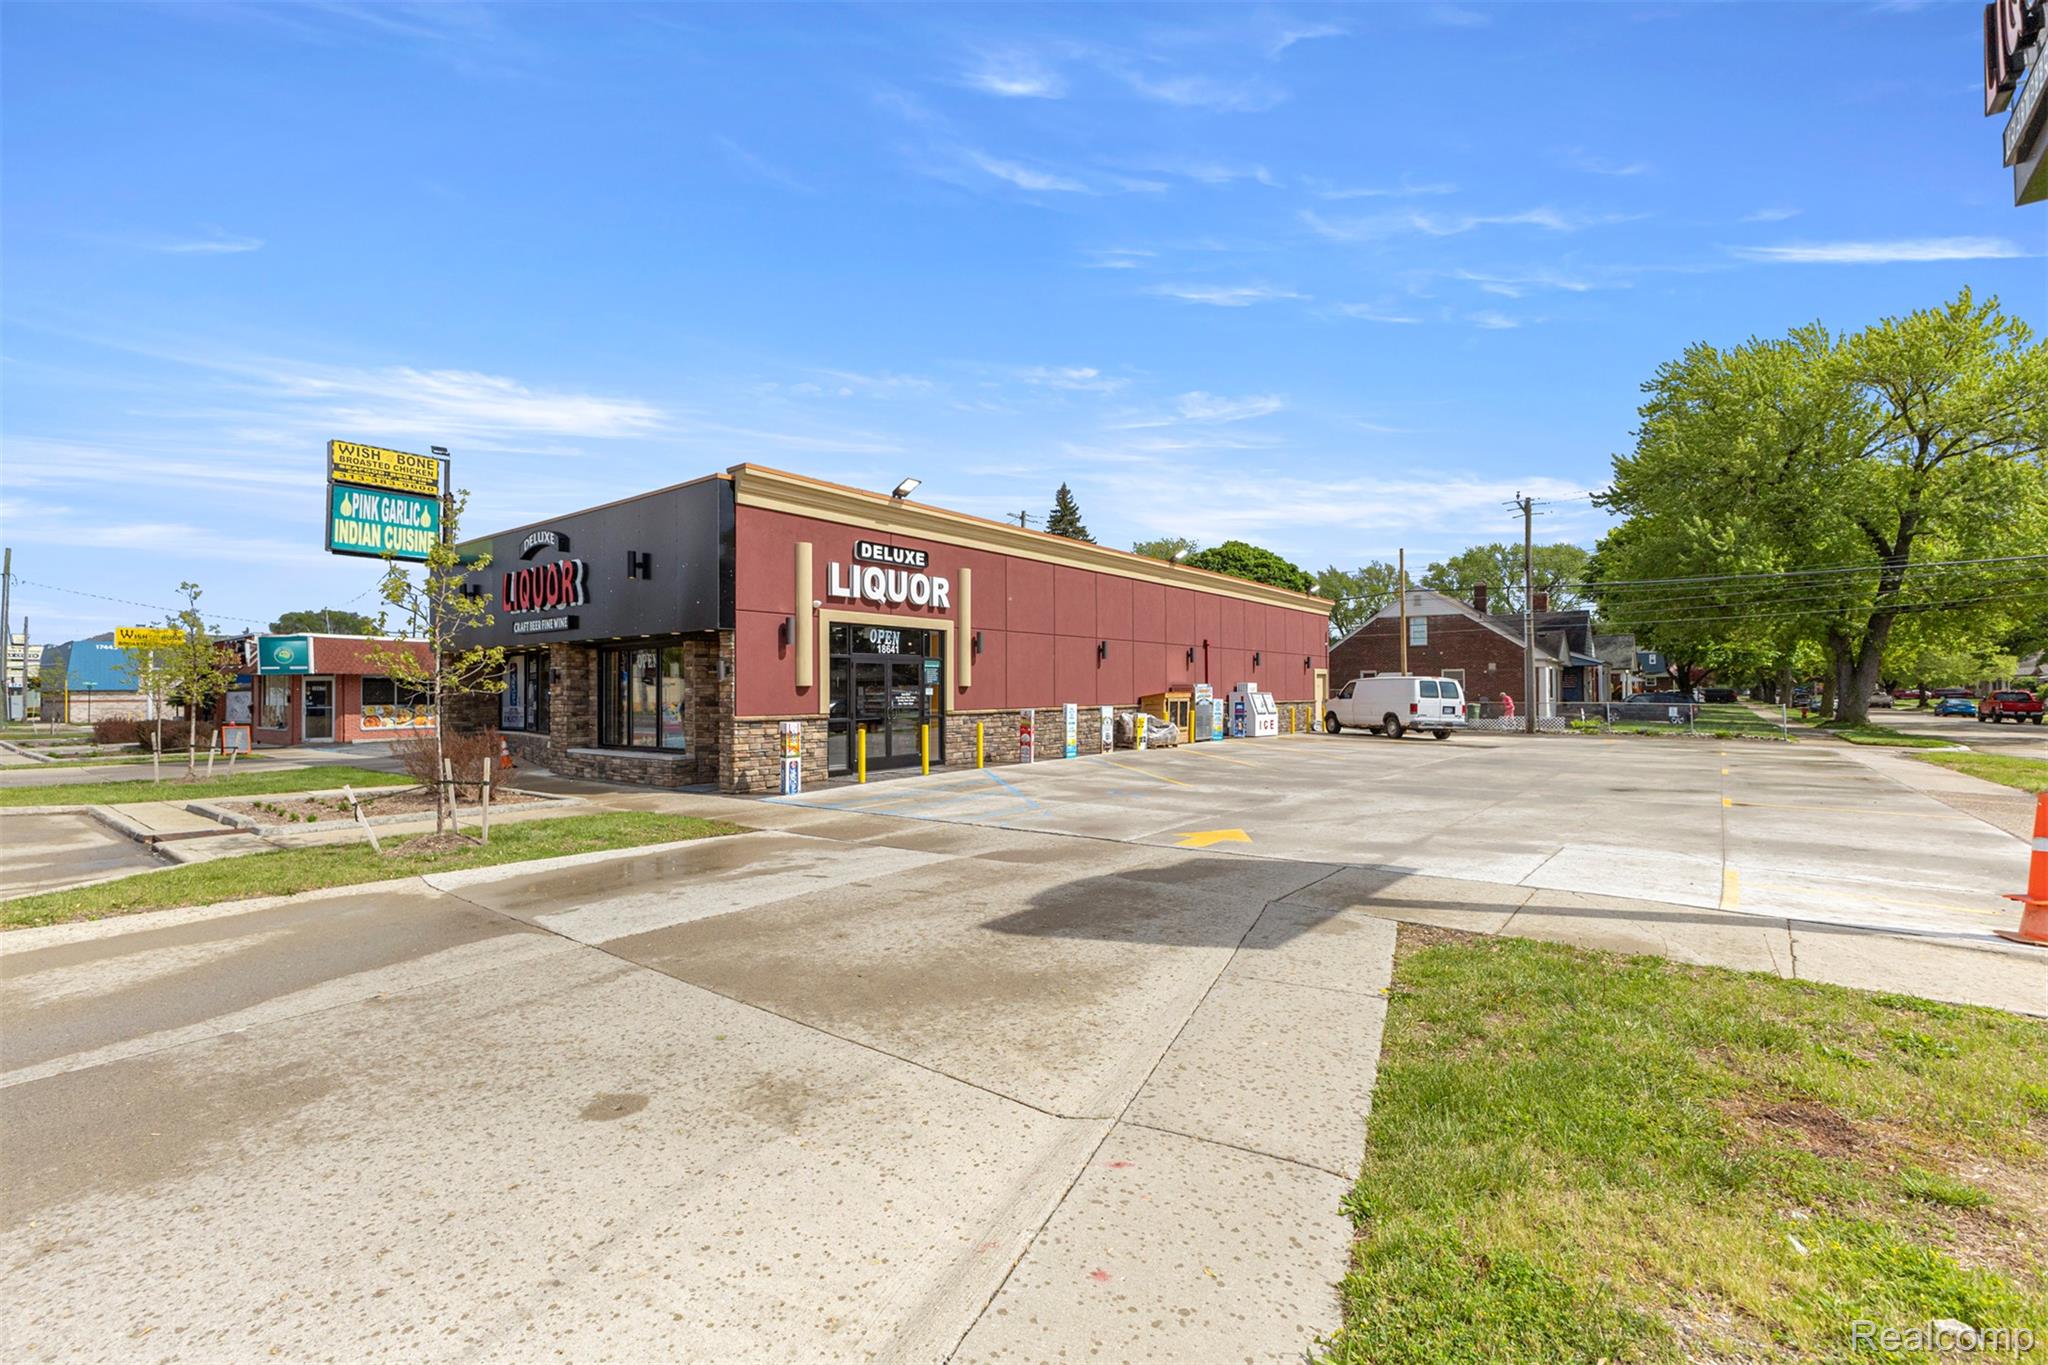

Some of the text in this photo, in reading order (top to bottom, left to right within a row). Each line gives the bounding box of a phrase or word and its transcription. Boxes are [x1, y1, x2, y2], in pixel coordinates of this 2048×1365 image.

[338, 443, 434, 471] WISH BONE
[339, 455, 391, 470] BROASTED
[393, 464, 434, 478] CHICKEN
[352, 492, 420, 527] PINK GARLIC
[334, 518, 435, 553] INDIAN CUISINE
[523, 531, 555, 551] DELUXE
[861, 542, 925, 567] DELUXE
[502, 559, 583, 614] LIQUOR
[828, 561, 950, 608] LIQUOR
[514, 617, 568, 633] CRAFT BEER FINE WINE
[869, 628, 901, 645] OPEN
[877, 644, 899, 655] 18641
[1259, 719, 1275, 730] ICE
